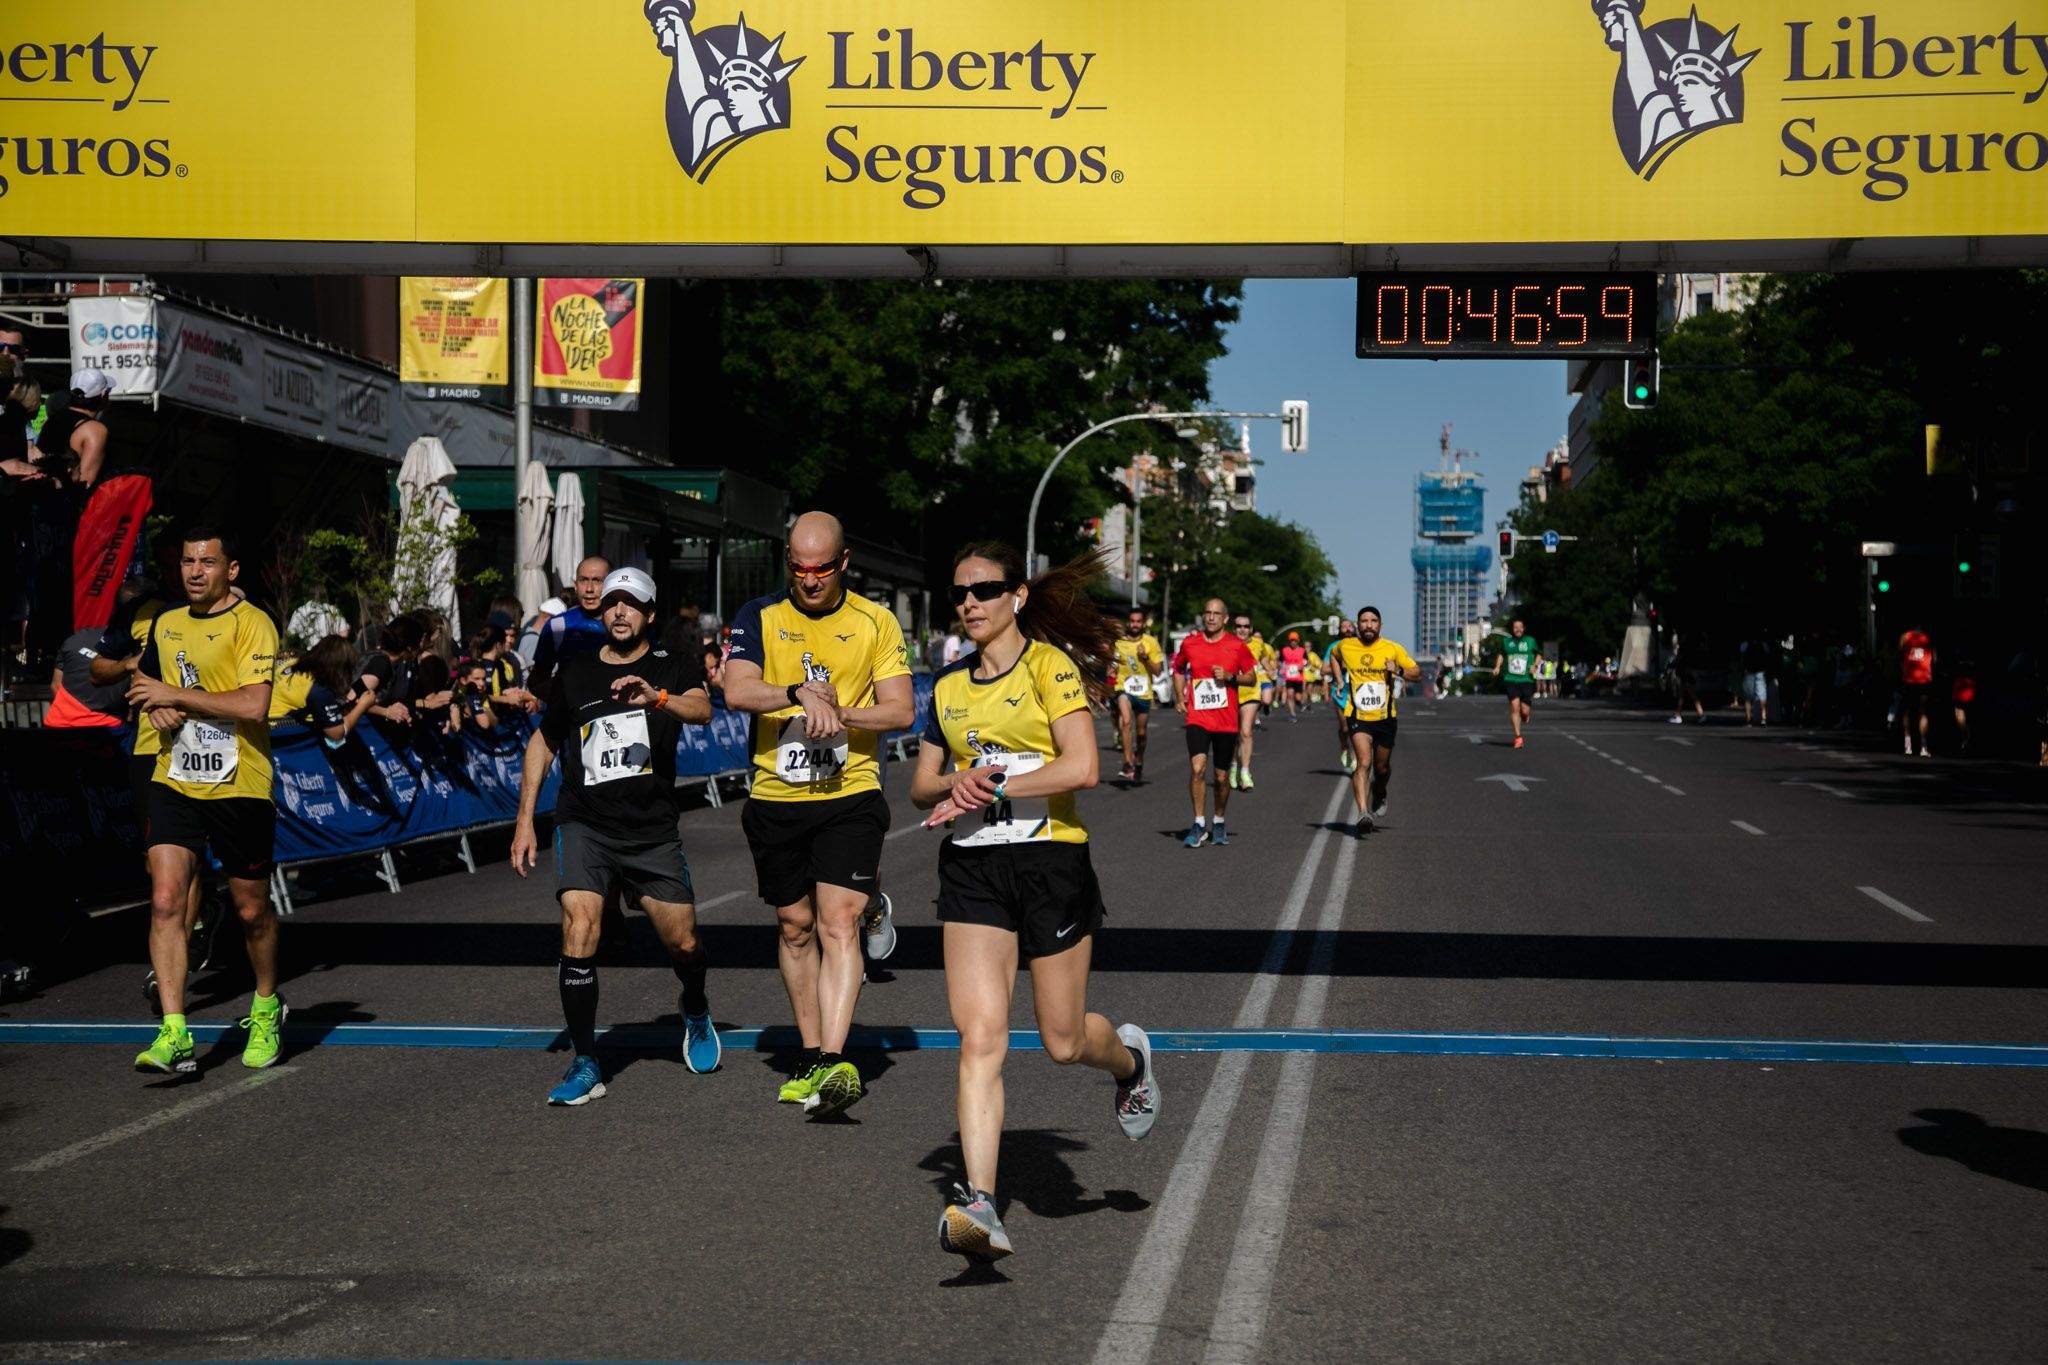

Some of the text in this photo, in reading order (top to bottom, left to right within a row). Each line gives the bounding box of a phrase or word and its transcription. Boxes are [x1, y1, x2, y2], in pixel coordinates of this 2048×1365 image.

[827, 28, 1096, 118] Liberty
[826, 125, 1107, 209] Seguros
[570, 297, 585, 310] LA
[554, 305, 603, 329] NOCHE
[1377, 285, 1634, 345] 00:46:59
[561, 329, 608, 346] DE LAS
[82, 355, 112, 369] TLF.
[116, 354, 142, 368] 952
[566, 345, 609, 371] IDEAS
[440, 388, 481, 398] MADRID
[572, 394, 611, 405] MADRID
[1201, 694, 1220, 704] 2581
[202, 730, 230, 740] 12604
[182, 752, 223, 771] 2016
[789, 748, 834, 769] 2244
[296, 771, 325, 796] Liberty
[303, 800, 335, 824] Seguros
